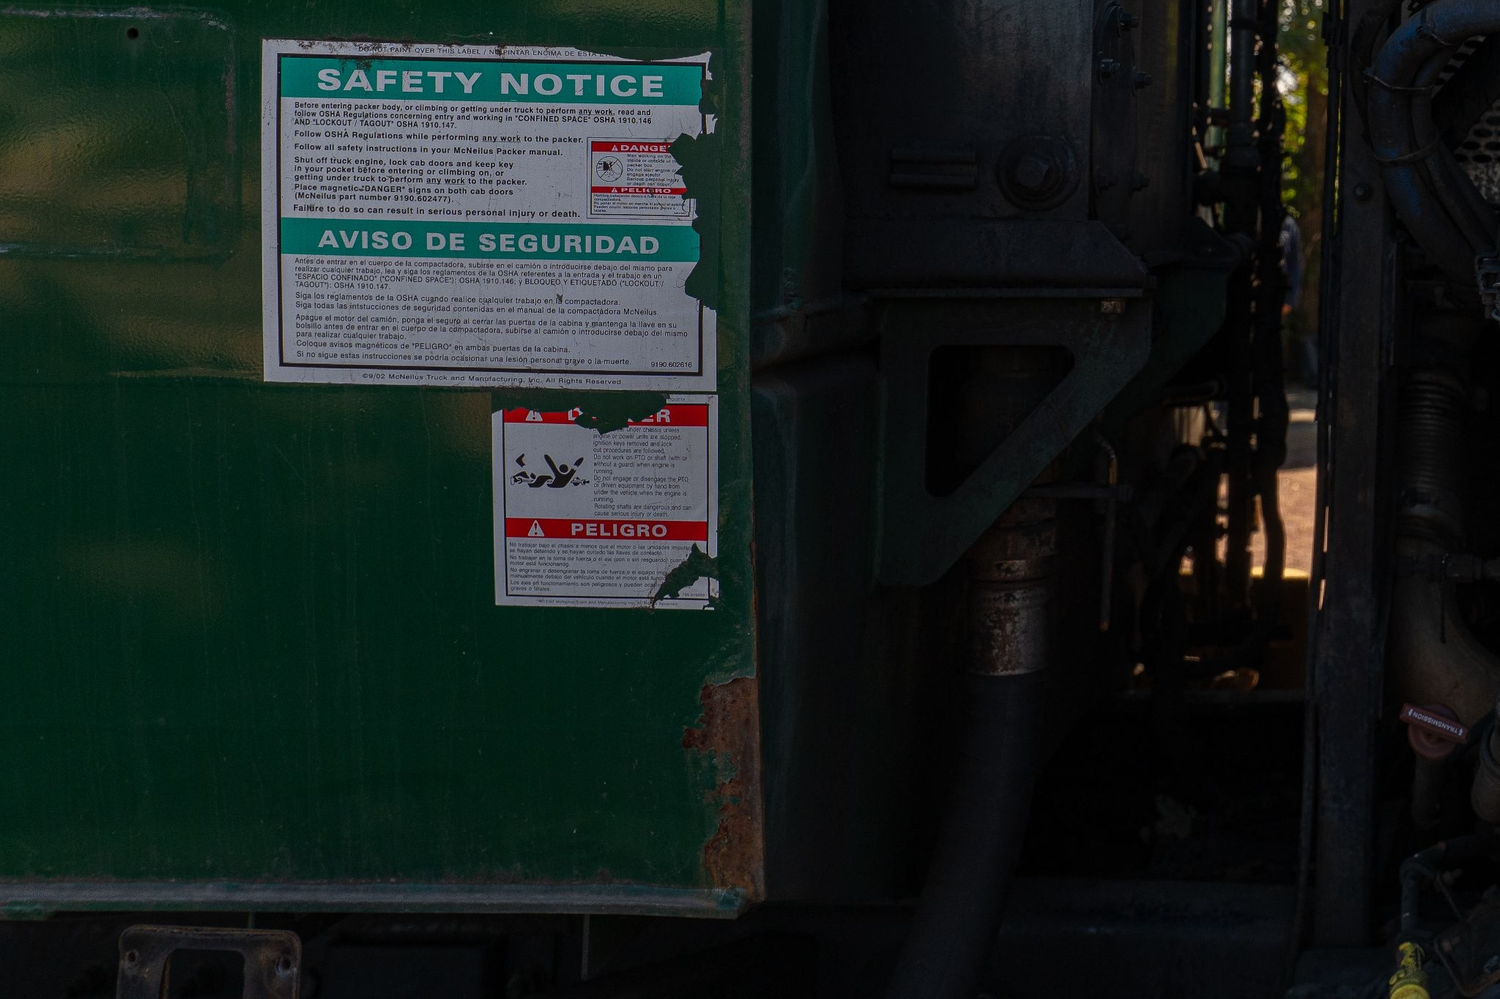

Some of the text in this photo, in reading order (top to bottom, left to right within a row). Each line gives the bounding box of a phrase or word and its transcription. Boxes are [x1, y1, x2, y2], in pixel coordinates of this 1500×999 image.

[317, 68, 662, 97] SAFETY NOTICE
[321, 102, 351, 110] entering
[382, 103, 402, 111] body,
[415, 104, 447, 112] climbing
[460, 105, 487, 113] getting
[546, 107, 575, 115] perform
[343, 111, 387, 119] Regulations
[434, 112, 453, 121] entry
[472, 114, 502, 122] working
[515, 114, 559, 122] "CONFINED
[351, 131, 403, 140] Regulations
[431, 133, 478, 141] performing
[337, 144, 362, 152] safety
[620, 144, 671, 152] DANGE
[354, 158, 385, 166] engine,
[498, 161, 513, 169] key
[465, 209, 505, 217] personal
[509, 209, 535, 217] injury
[317, 230, 658, 254] AVISO DE SEGURIDAD
[296, 339, 327, 347] Coloque
[354, 342, 397, 350] magnéticos
[411, 342, 452, 350] "PELIGRO"
[571, 523, 667, 537] PELIGRO
[1413, 712, 1458, 733] TRANSMISSION
